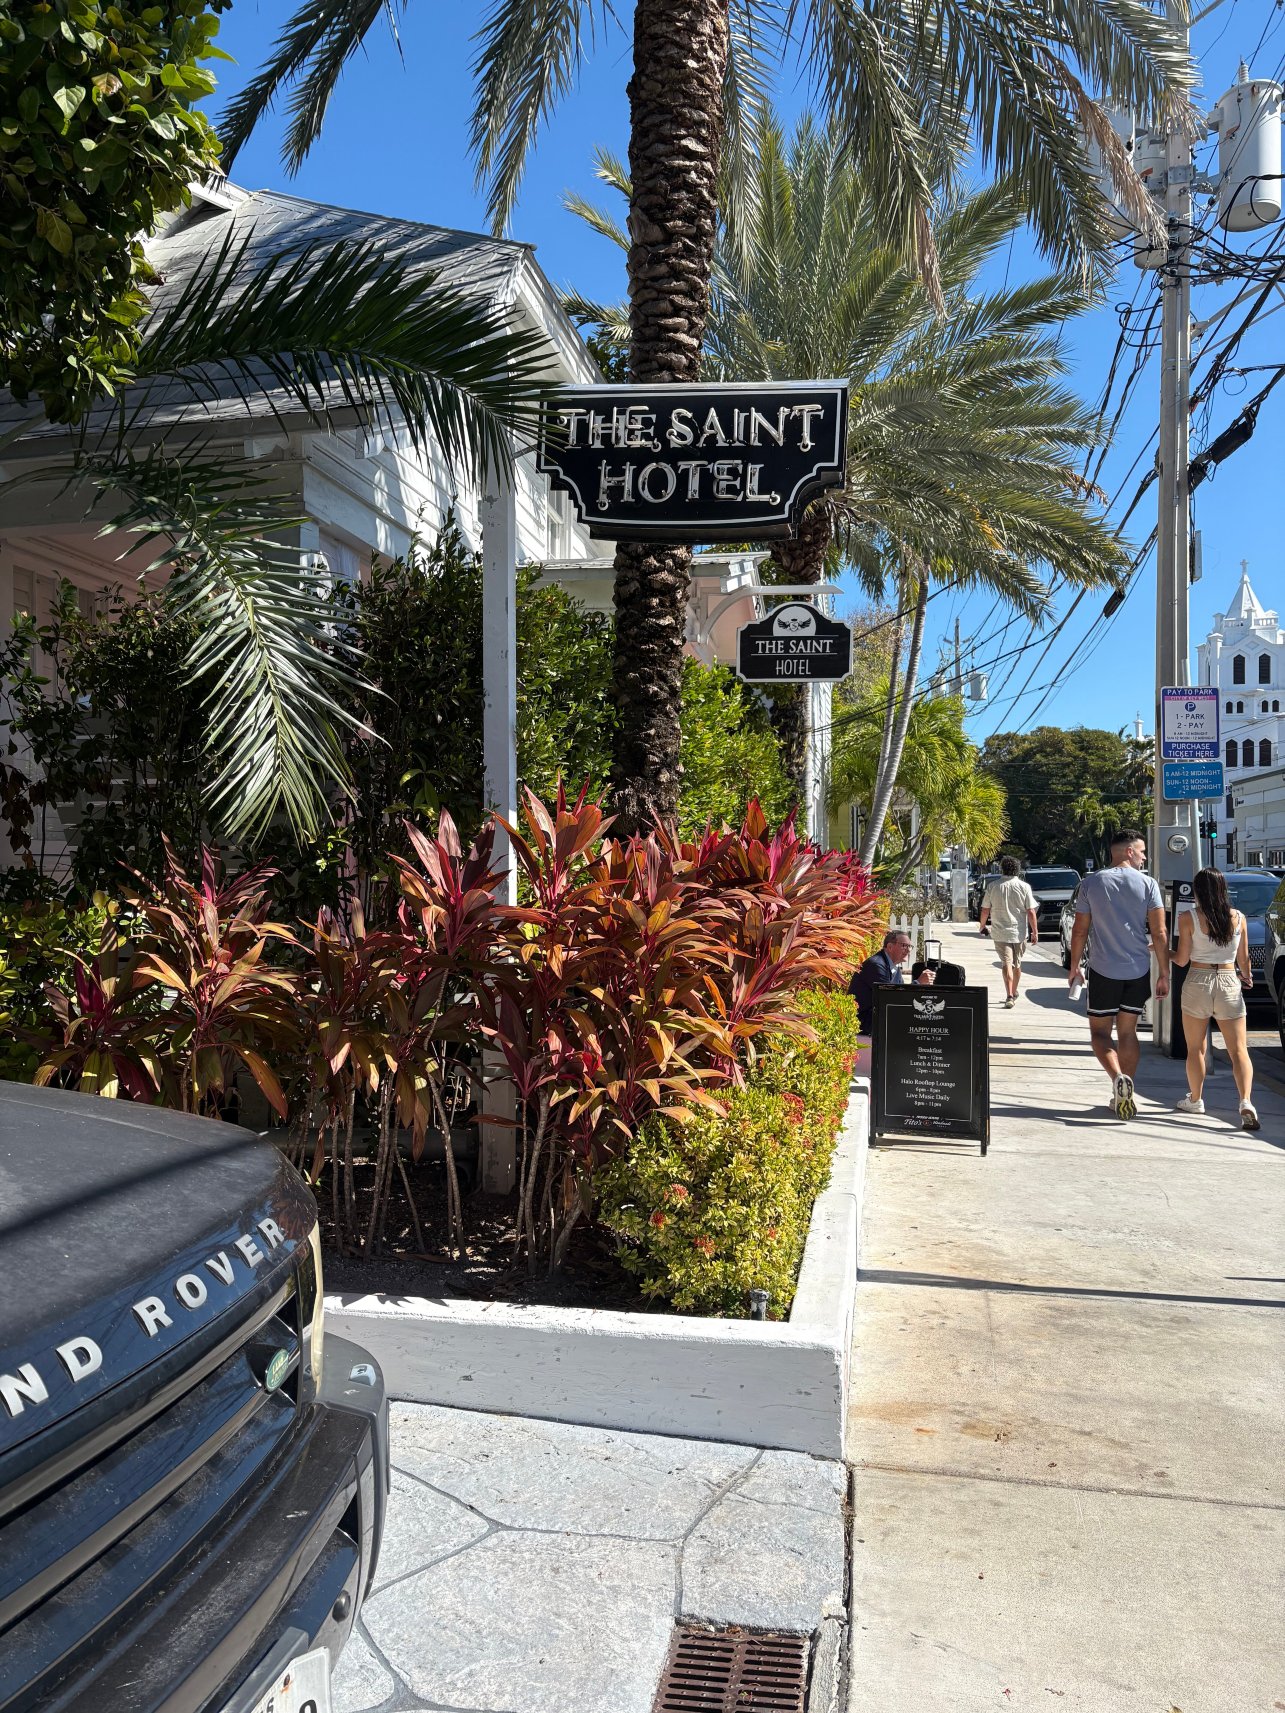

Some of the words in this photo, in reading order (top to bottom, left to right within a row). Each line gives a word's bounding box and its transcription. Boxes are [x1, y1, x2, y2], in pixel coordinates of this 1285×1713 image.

[558, 405, 662, 452] THE
[666, 404, 824, 452] SAINT
[597, 459, 780, 510] HOTEL
[755, 640, 785, 654] THE
[788, 639, 834, 653] SAINT
[775, 659, 812, 676] HOTEL
[918, 1046, 943, 1054] Breakfast
[914, 1079, 935, 1087] Rooftop
[936, 1080, 956, 1088] Lounge
[904, 1118, 922, 1126] Tito's
[131, 1217, 285, 1338] ROVER
